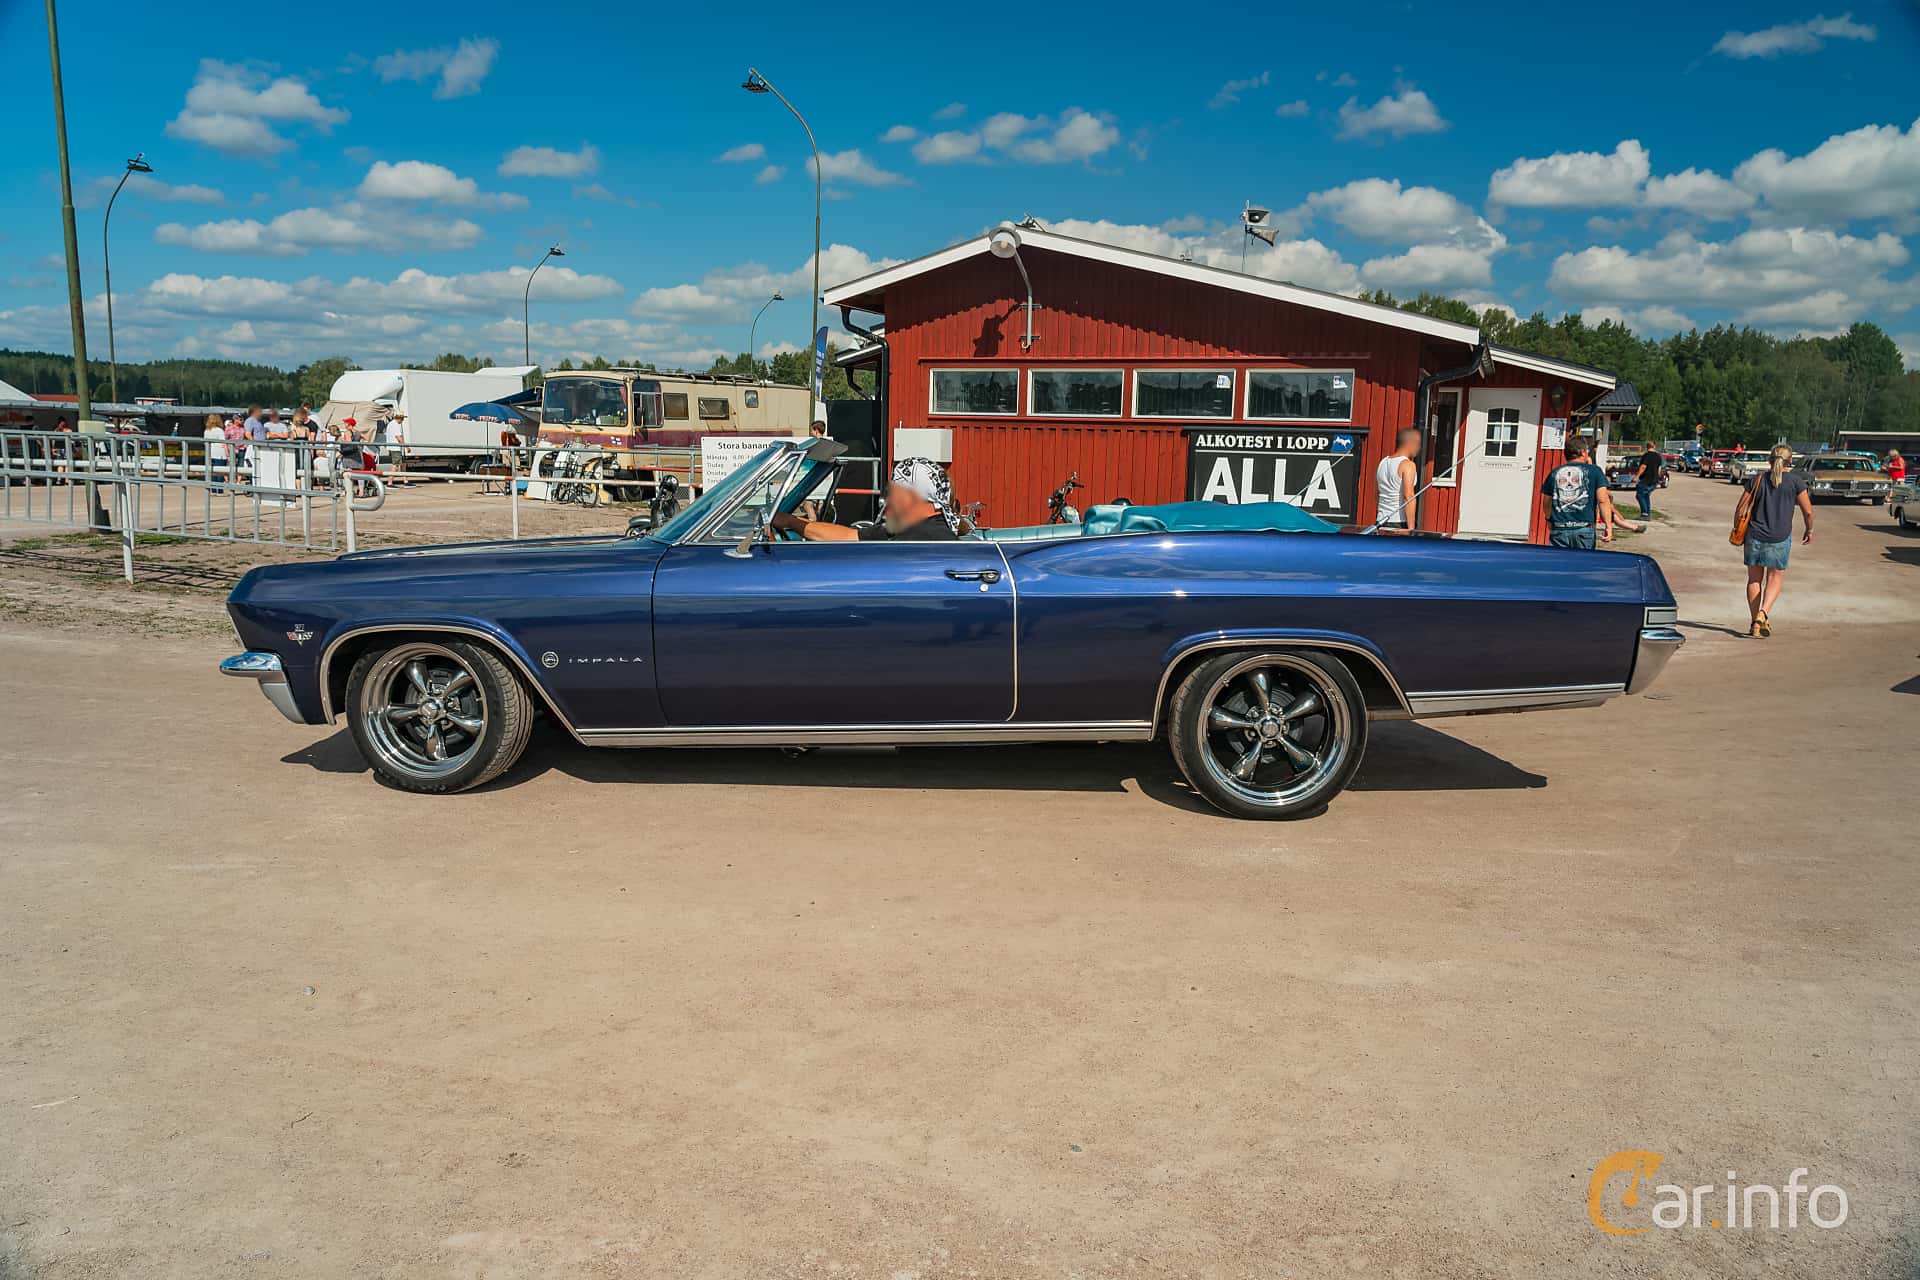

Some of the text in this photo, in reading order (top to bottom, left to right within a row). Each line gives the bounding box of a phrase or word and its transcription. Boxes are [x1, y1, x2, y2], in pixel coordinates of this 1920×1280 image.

[718, 441, 740, 450] Stora
[1195, 434, 1329, 450] ALKOTEST I LOPP
[1202, 457, 1341, 509] ALLA
[568, 656, 643, 664] IMPALA
